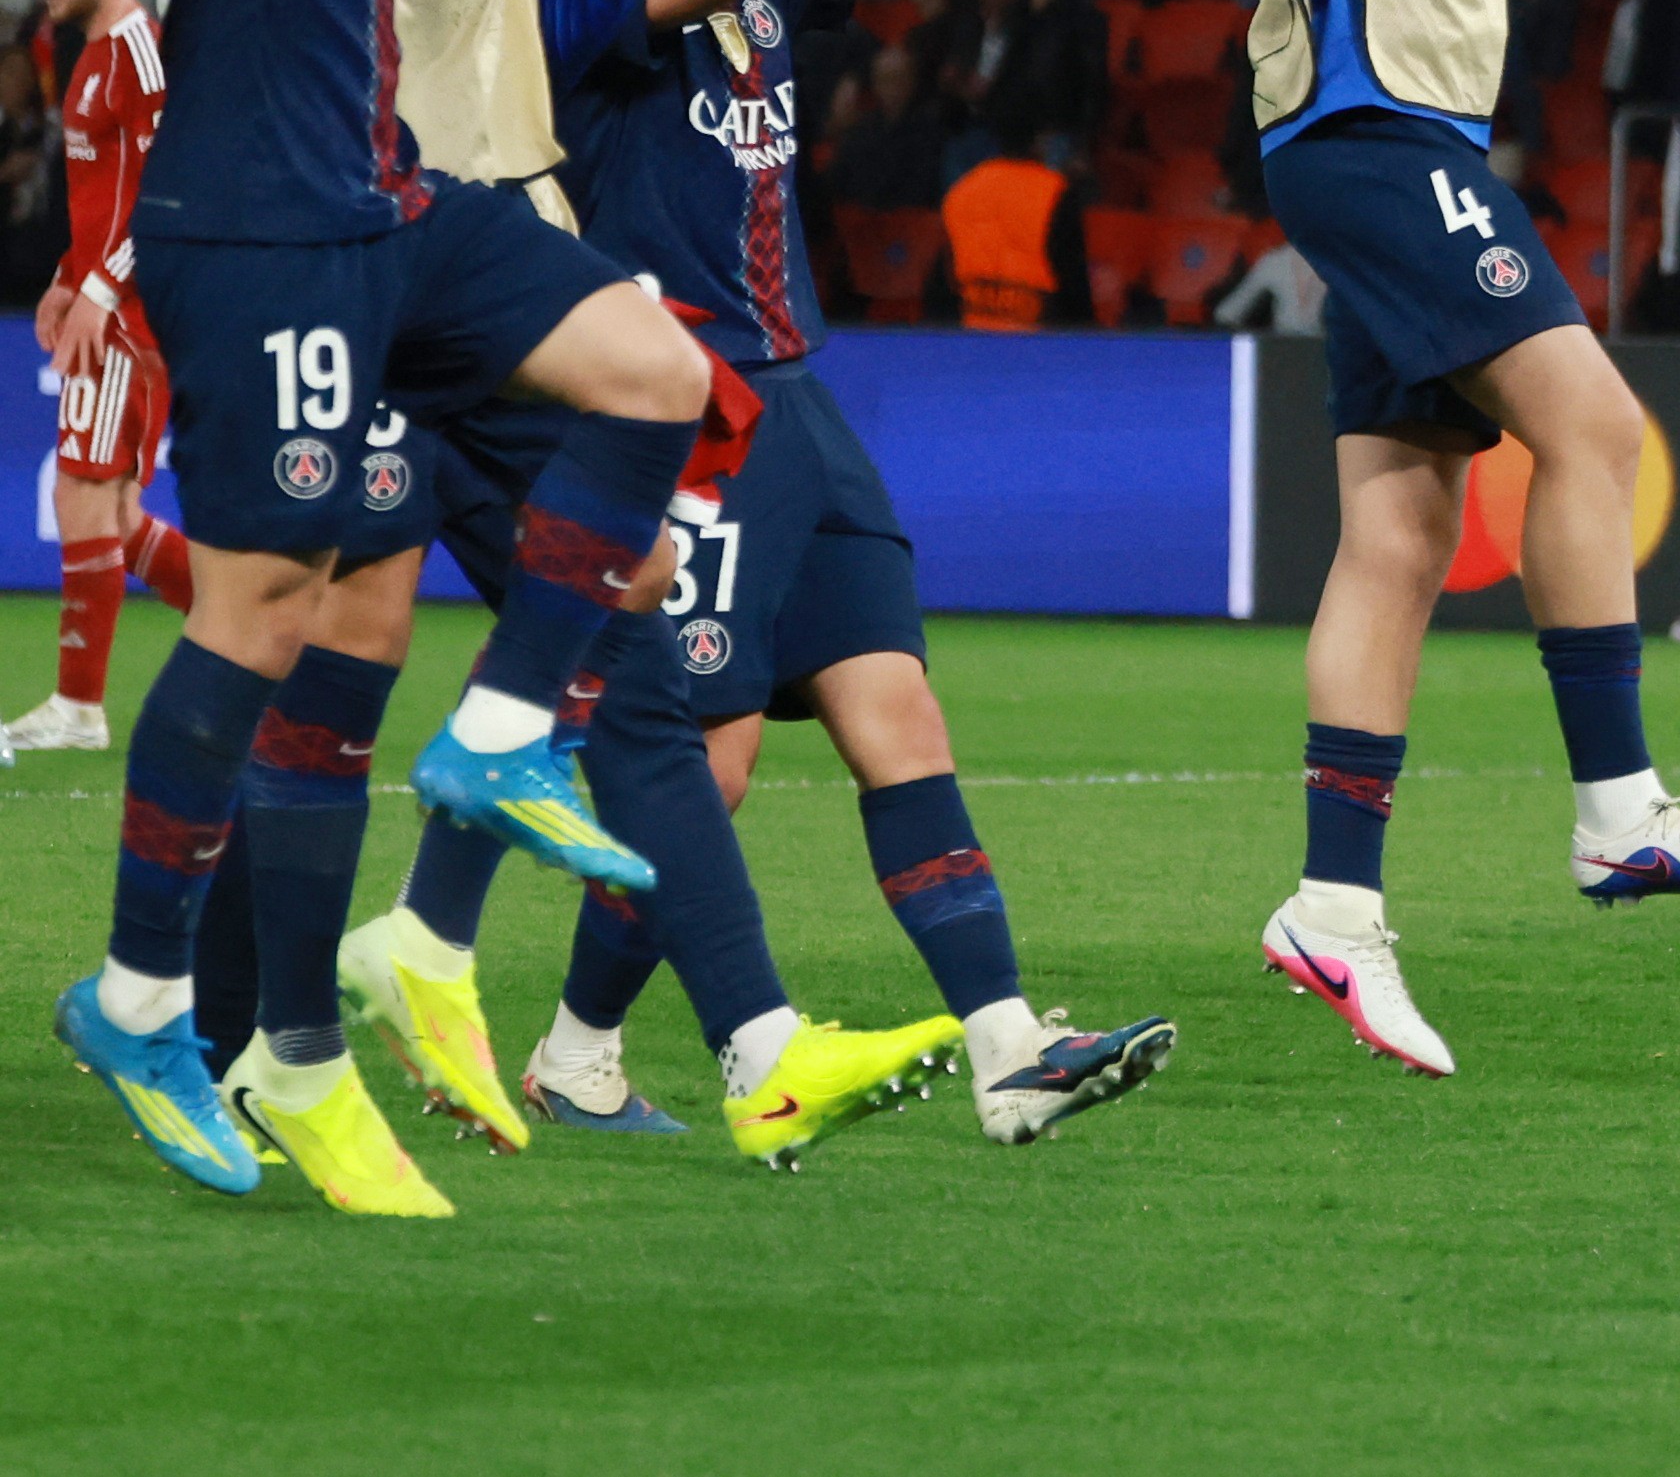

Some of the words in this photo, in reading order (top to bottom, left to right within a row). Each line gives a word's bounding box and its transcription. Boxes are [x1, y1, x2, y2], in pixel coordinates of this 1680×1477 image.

[1429, 168, 1496, 240] 4
[264, 327, 352, 431] 19
[683, 622, 719, 638] PARIS
